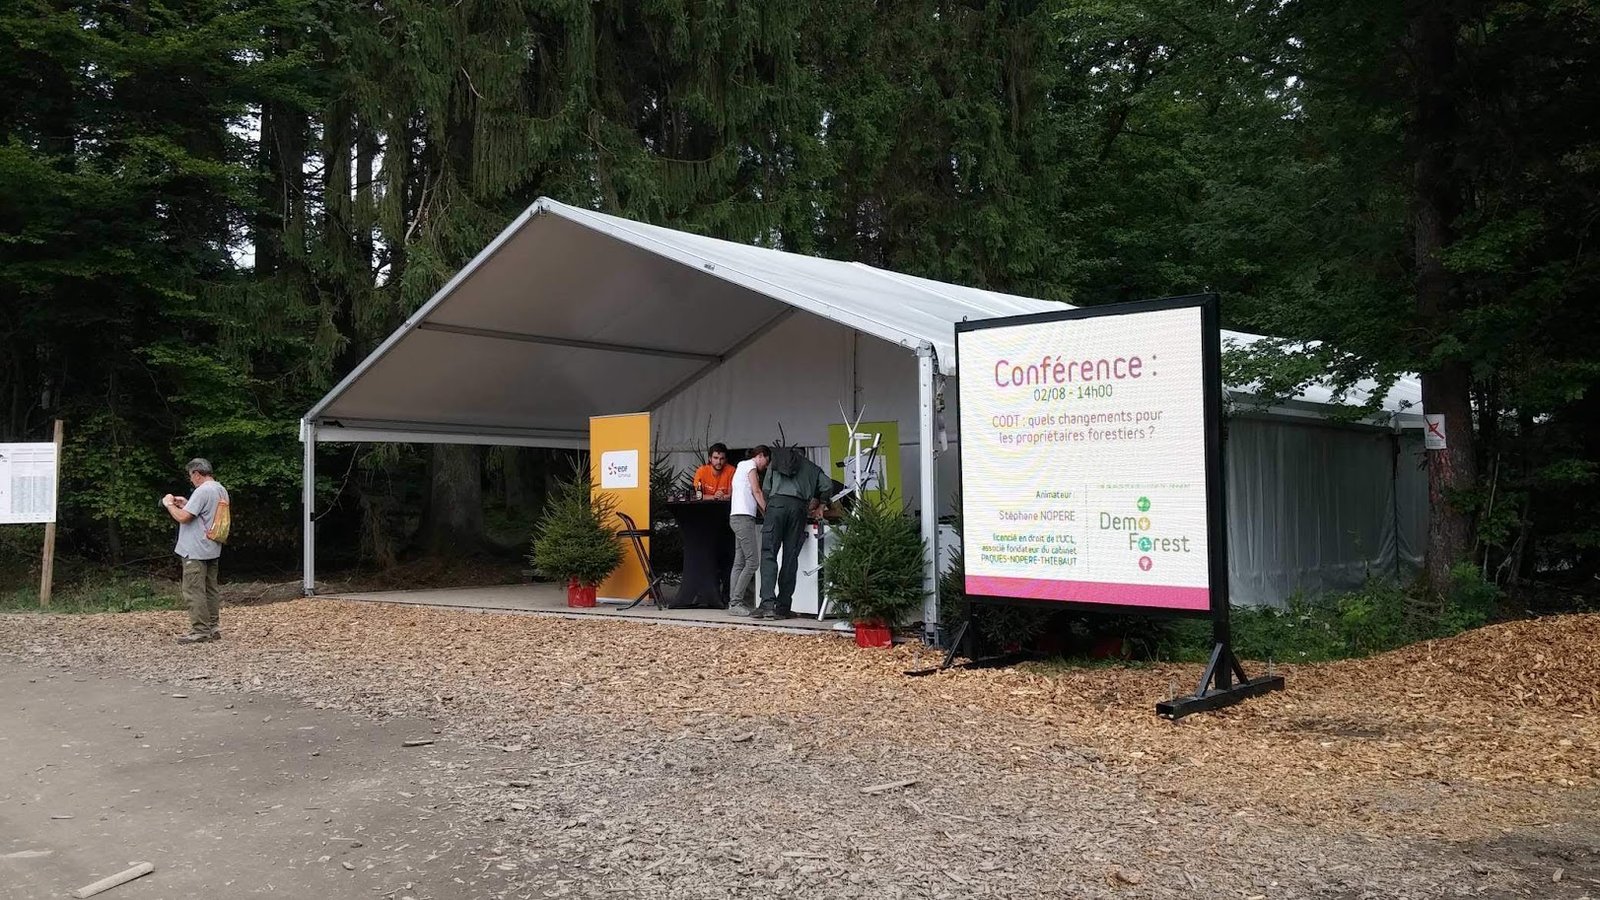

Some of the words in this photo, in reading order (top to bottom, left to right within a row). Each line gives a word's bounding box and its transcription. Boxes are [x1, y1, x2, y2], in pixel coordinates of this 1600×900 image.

[995, 355, 1142, 387] Conférence
[1034, 387, 1066, 402] 02/08
[1077, 384, 1113, 399] 14h00
[992, 414, 1019, 428] CODT
[1027, 414, 1055, 429] quels
[1058, 410, 1132, 427] changements
[1135, 410, 1163, 424] pour
[999, 432, 1013, 444] les
[1016, 430, 1084, 446] propriétaires
[1088, 427, 1145, 441] forestiers
[1149, 426, 1155, 439] ?
[1035, 490, 1072, 499] Animateur
[1028, 534, 1045, 543] droit
[1046, 534, 1054, 543] de
[1129, 532, 1191, 553] Forest
[1041, 545, 1049, 554] du
